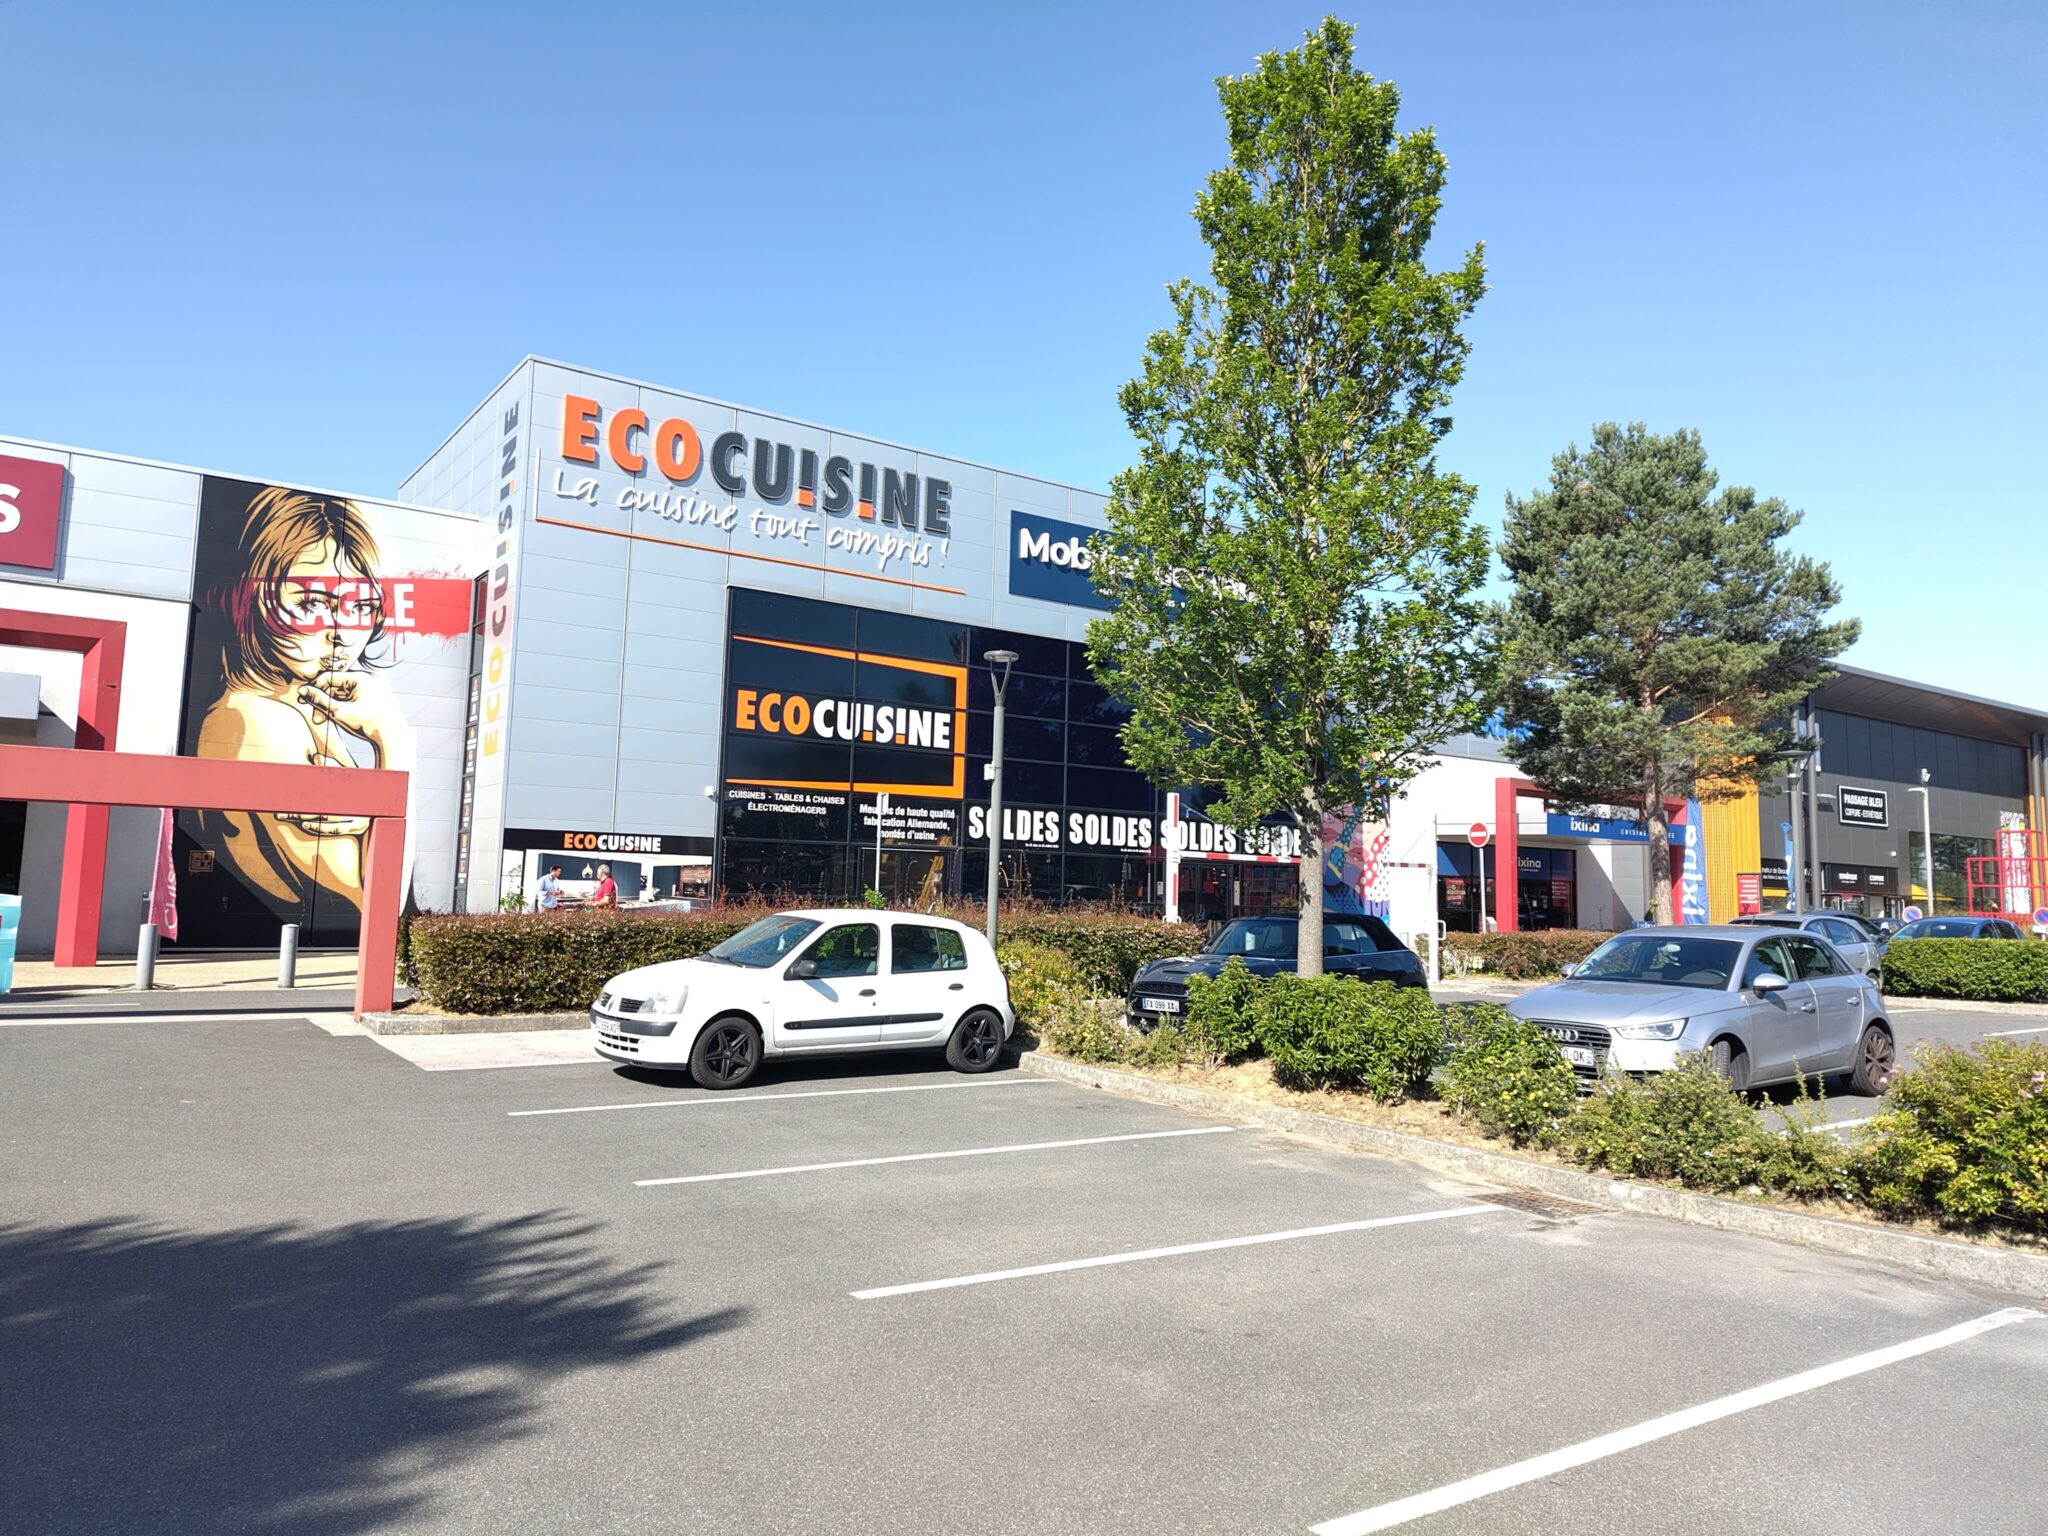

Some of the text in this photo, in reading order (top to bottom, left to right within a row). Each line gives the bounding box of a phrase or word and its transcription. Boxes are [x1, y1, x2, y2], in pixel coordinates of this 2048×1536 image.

[554, 467, 598, 503] La
[616, 483, 738, 530] cuisine
[749, 508, 820, 543] tout
[827, 527, 932, 571] compris
[728, 790, 766, 800] CUISINES
[774, 793, 804, 802] TABLES
[812, 795, 845, 805] CHAISES
[1844, 793, 1883, 808] PASSAGE BLEU
[747, 802, 827, 815] ÉLECTROMÉNAGERS
[895, 806, 905, 816] de
[907, 807, 928, 817] haute
[1069, 812, 1153, 849] SOLDES
[1682, 825, 1705, 916] ixina
